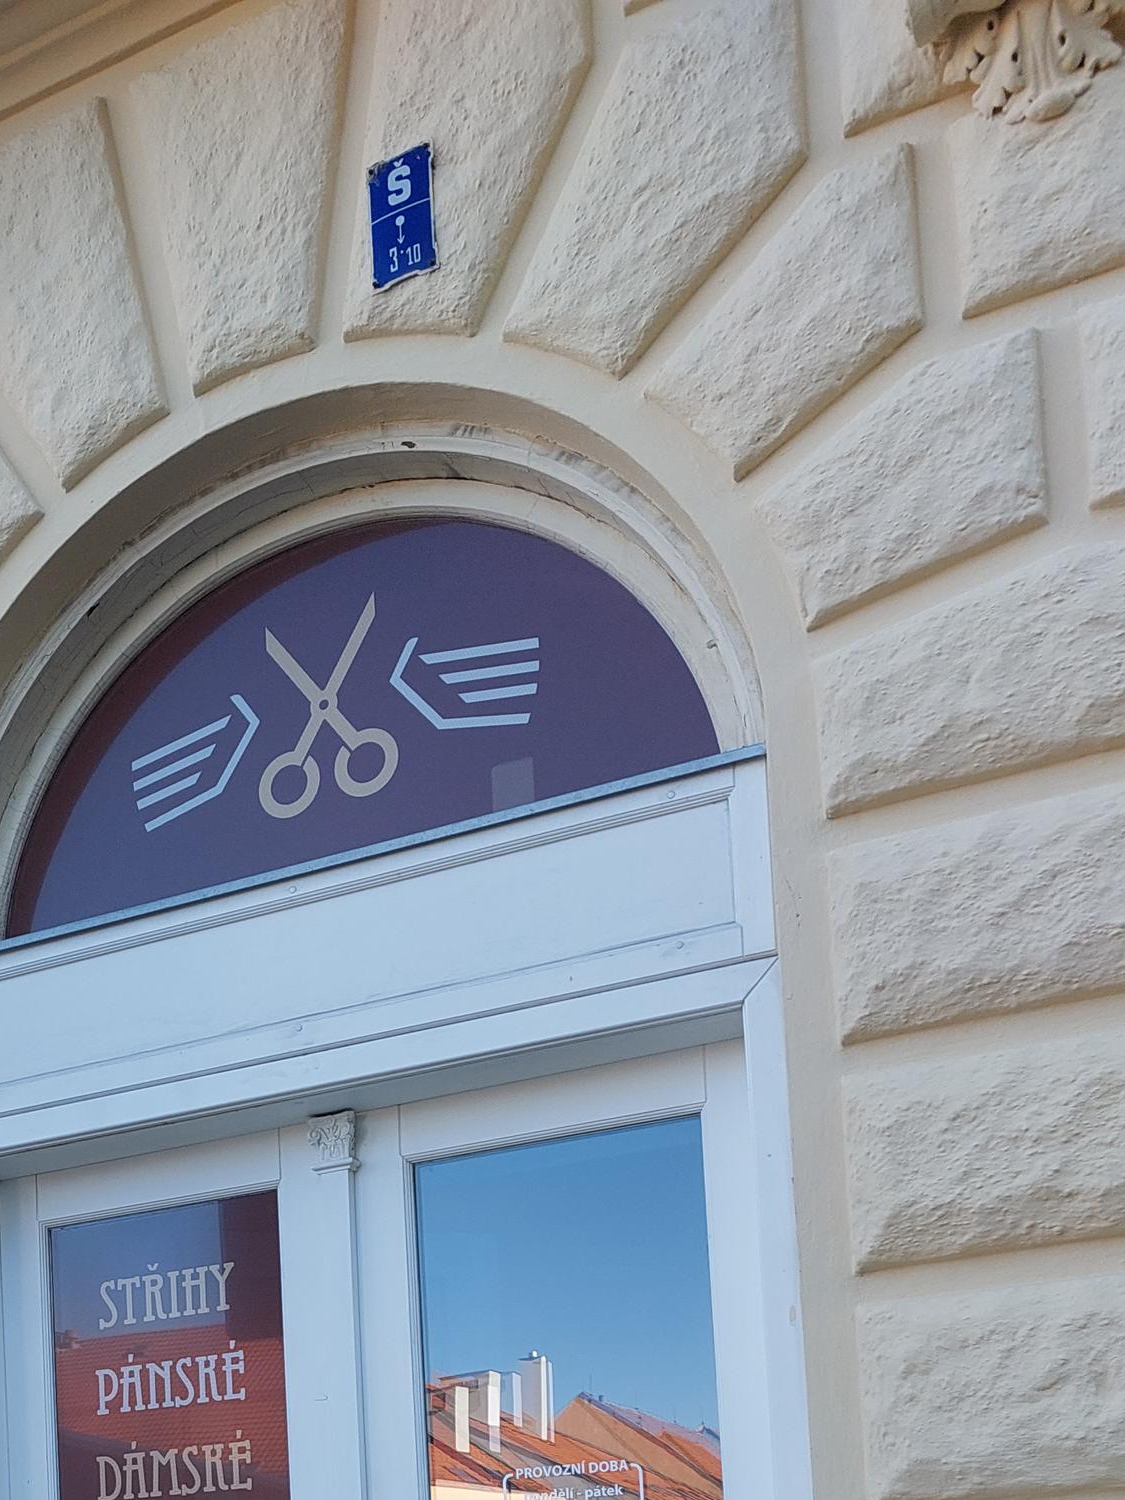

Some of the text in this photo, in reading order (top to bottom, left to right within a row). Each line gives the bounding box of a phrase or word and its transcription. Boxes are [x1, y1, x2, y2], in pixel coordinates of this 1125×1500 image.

[99, 1262, 235, 1330] STŘIHY
[95, 1339, 246, 1416] PÁNSKÉ
[515, 1459, 629, 1479] PROVOZNÍ DOBA
[585, 1484, 624, 1500] pátek
